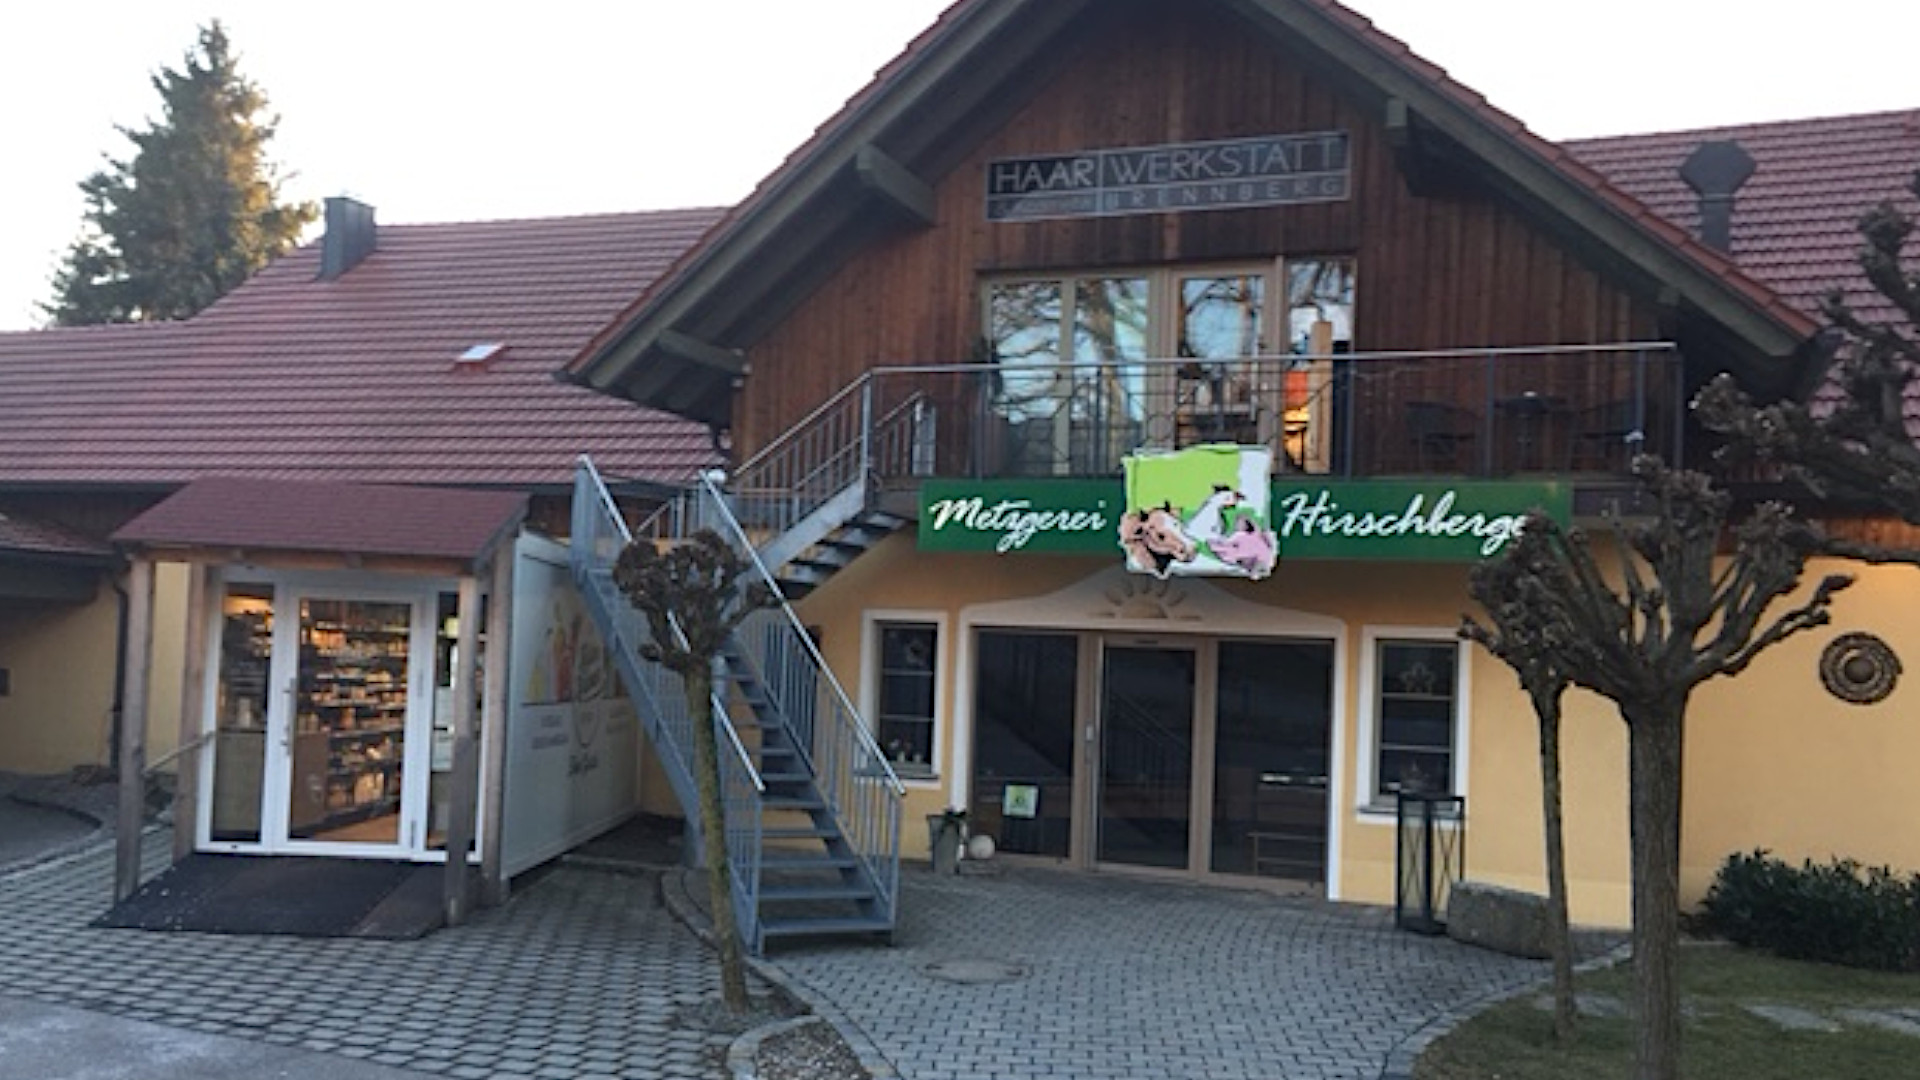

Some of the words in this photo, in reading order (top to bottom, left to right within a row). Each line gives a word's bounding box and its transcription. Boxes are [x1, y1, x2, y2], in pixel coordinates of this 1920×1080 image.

[995, 158, 1095, 192] HAAR
[1109, 138, 1341, 185] WERKSTATT
[928, 496, 1107, 553] Metzgerei
[1281, 490, 1528, 556] Hirschberge
